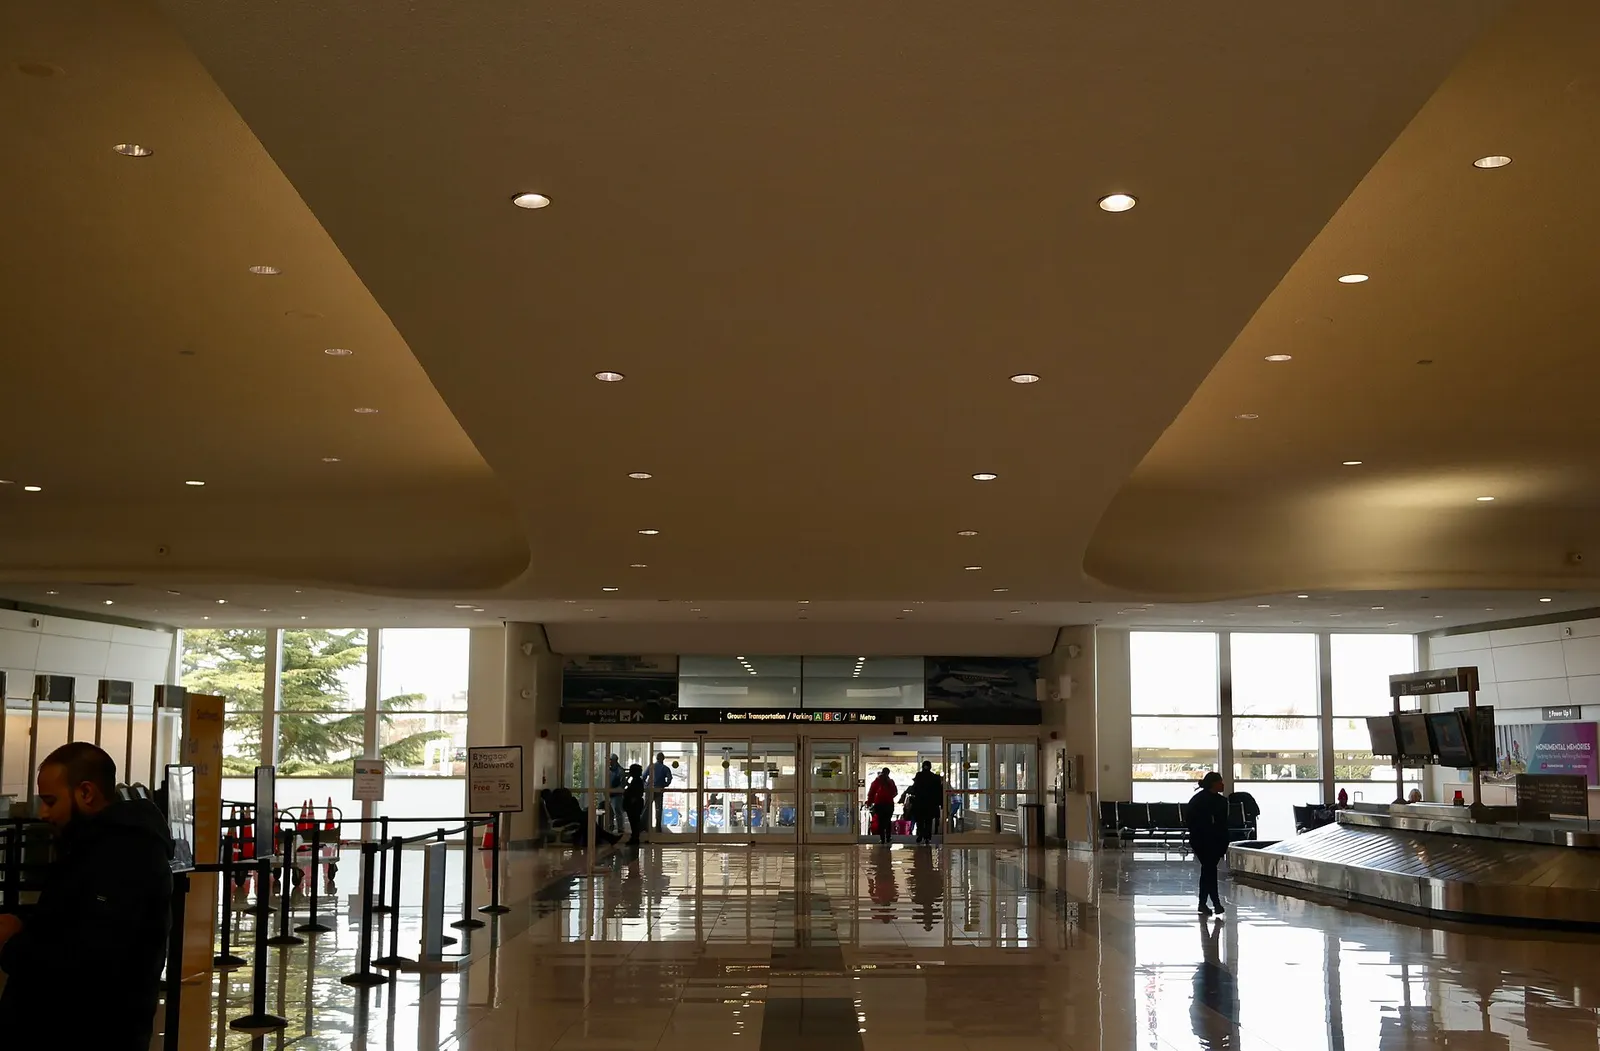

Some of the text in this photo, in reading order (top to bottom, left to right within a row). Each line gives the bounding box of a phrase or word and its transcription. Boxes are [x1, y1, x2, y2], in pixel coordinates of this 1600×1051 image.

[663, 713, 689, 721] EXIT
[726, 712, 747, 720] Ground
[748, 712, 786, 720] Transportation
[793, 712, 814, 722] Parking
[815, 712, 823, 721] A
[824, 713, 831, 721] B
[833, 713, 840, 721] C
[859, 713, 877, 721] Metro
[913, 714, 939, 722] EXIT
[1551, 709, 1570, 718] Power Up
[1535, 742, 1591, 751] MONUMENTAL MEMORIES
[472, 753, 508, 762] Baggage
[498, 783, 511, 791] $75
